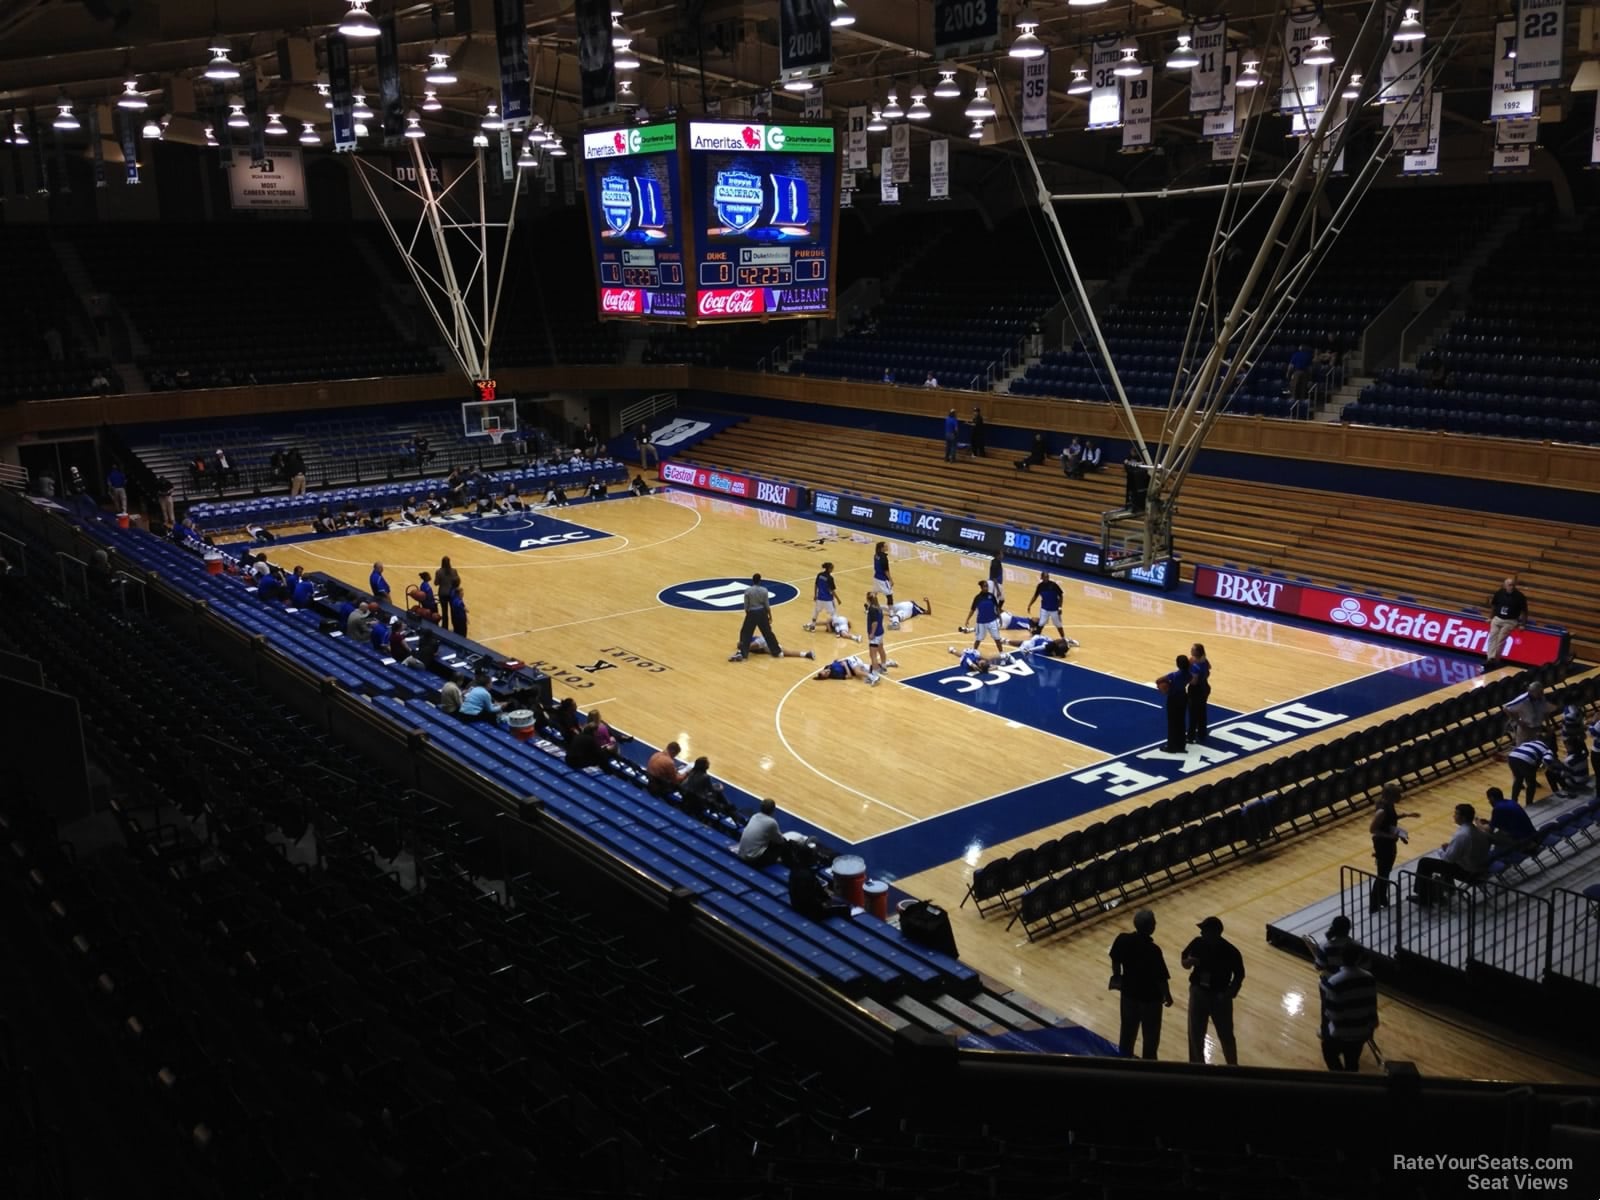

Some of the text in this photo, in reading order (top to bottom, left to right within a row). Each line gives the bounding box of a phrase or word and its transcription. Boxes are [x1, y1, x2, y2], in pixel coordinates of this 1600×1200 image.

[943, 0, 987, 32] 2003
[1524, 12, 1558, 39] 22
[788, 31, 822, 58] 2004
[1195, 34, 1222, 48] HURLEY
[1027, 64, 1045, 76] FERRY
[1200, 52, 1215, 73] 11
[1096, 69, 1115, 88] 32
[1026, 79, 1044, 98] 35
[396, 167, 439, 182] DUE
[719, 186, 760, 199] CAMERON
[707, 252, 727, 260] DUKE
[795, 249, 825, 257] PURDUE
[612, 264, 619, 280] 0
[672, 265, 679, 282] 0
[720, 264, 728, 281] 0
[812, 262, 820, 278] 0
[603, 289, 637, 312] Coca-Cola
[700, 289, 756, 314] Coca-Cola
[780, 288, 829, 303] VALEANT
[671, 468, 694, 483] Castrol
[757, 482, 790, 505] BB&T
[851, 505, 873, 519] ESPN
[916, 514, 943, 532] ACC
[520, 531, 591, 548] ACC
[960, 528, 985, 542] ESPN
[1036, 539, 1067, 558] ACC
[1214, 571, 1283, 610] BB&T
[576, 660, 618, 673] K
[600, 647, 666, 673] COURT
[529, 660, 595, 689] COACH
[938, 659, 1035, 694] ACC
[1070, 702, 1350, 797] DUKE
